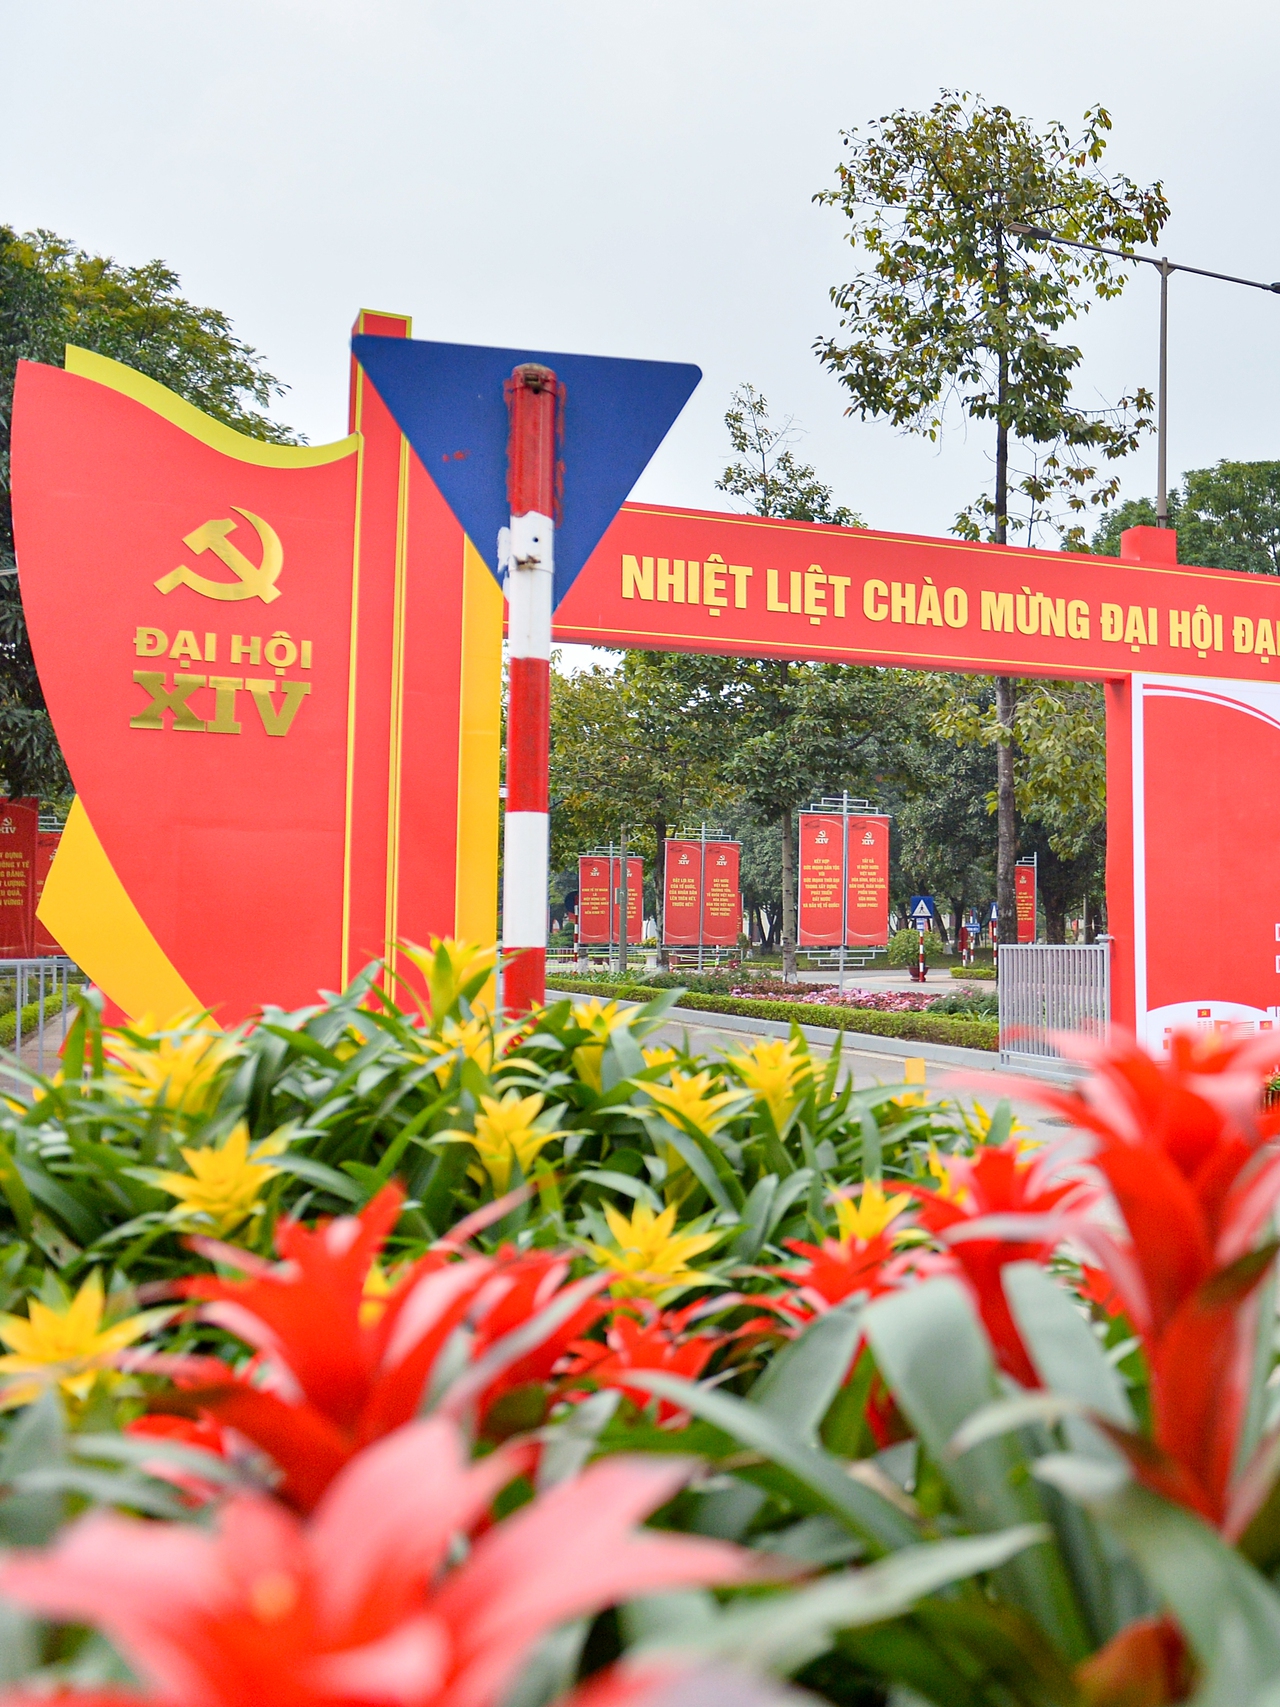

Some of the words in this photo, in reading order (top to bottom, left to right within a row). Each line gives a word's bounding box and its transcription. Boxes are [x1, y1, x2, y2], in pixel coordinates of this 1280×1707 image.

[621, 554, 753, 617] NHIỆT
[766, 564, 851, 625] LIỆT
[862, 576, 968, 629] CHÀO
[980, 586, 1090, 640] MỪNG
[1100, 603, 1158, 653] ĐẠI
[1169, 605, 1223, 659] HỘI
[133, 627, 216, 668] ĐẠI
[230, 631, 312, 676] HỘI
[130, 670, 311, 736] XIV
